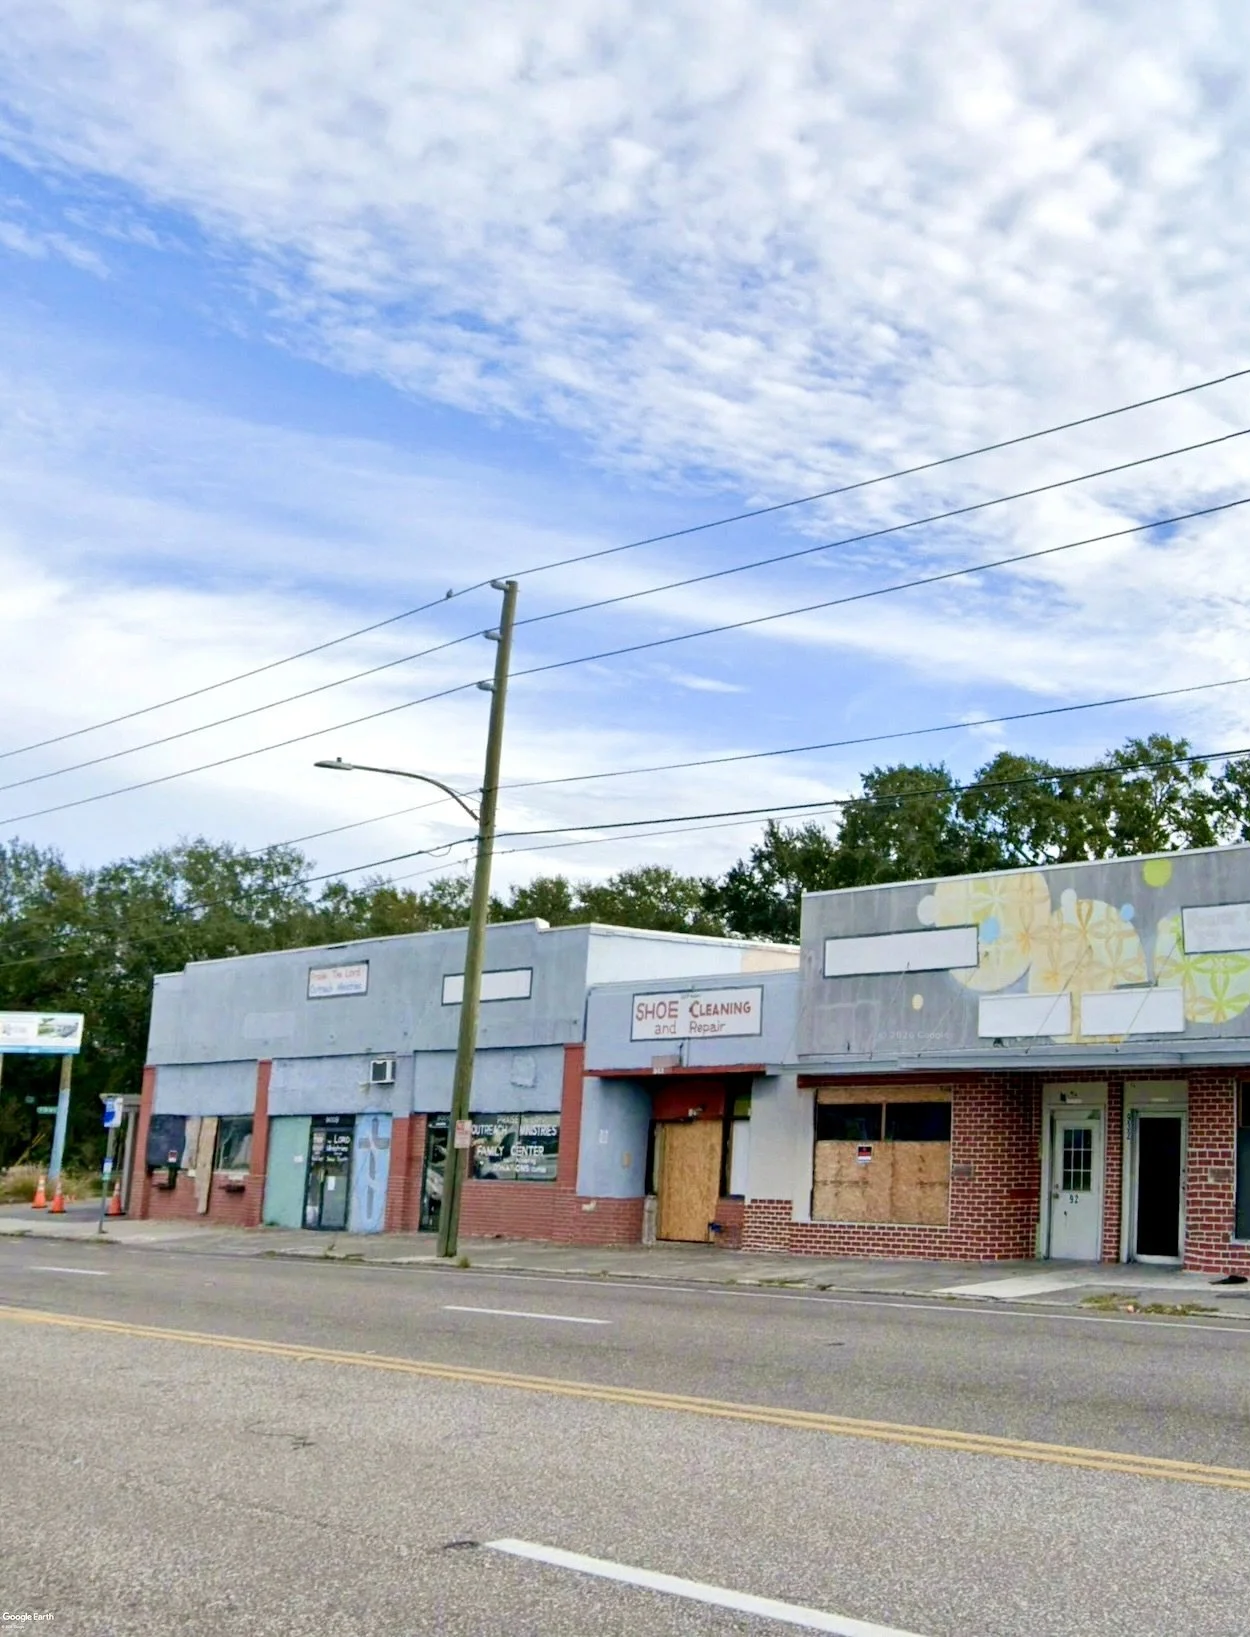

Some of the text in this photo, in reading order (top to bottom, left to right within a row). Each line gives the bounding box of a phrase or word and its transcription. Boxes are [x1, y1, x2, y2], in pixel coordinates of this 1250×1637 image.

[636, 1000, 751, 1021] SHOE CLEANING
[654, 1020, 726, 1035] and Repair
[476, 1145, 545, 1157] FAMILY CENTER
